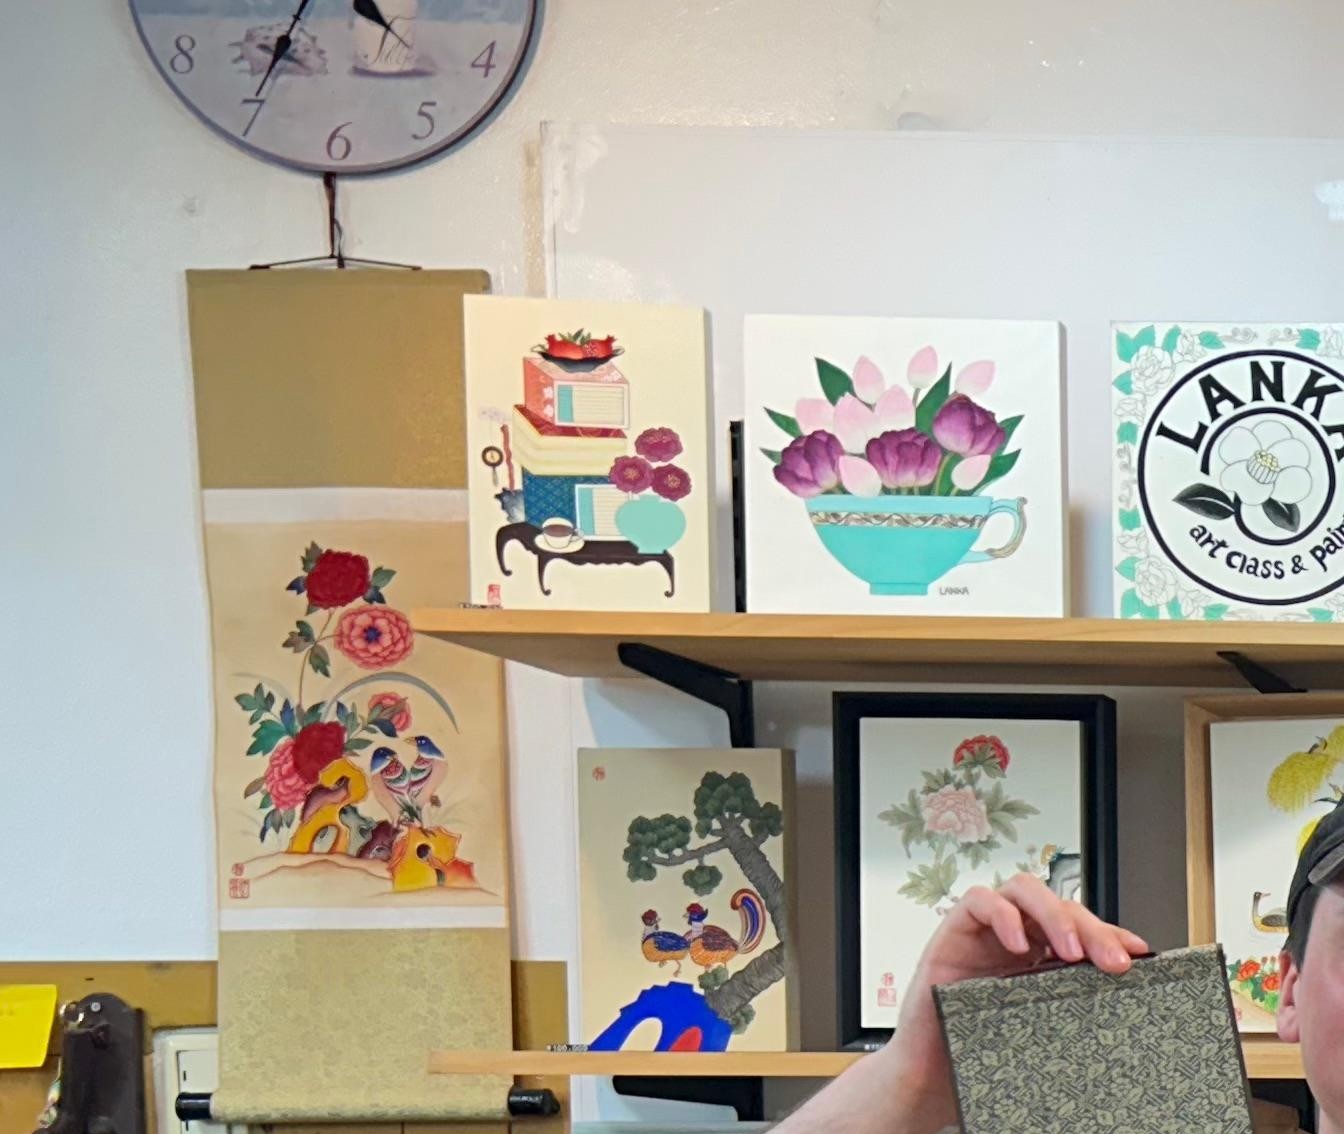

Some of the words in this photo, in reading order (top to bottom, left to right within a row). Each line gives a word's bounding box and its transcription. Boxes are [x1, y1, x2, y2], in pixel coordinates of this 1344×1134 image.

[169, 34, 196, 74] 8
[470, 40, 497, 78] 4
[241, 98, 266, 137] 7
[411, 101, 437, 140] 5
[326, 121, 353, 161] 6
[1190, 523, 1230, 559] art
[1225, 549, 1286, 580] class
[1291, 555, 1309, 576] &
